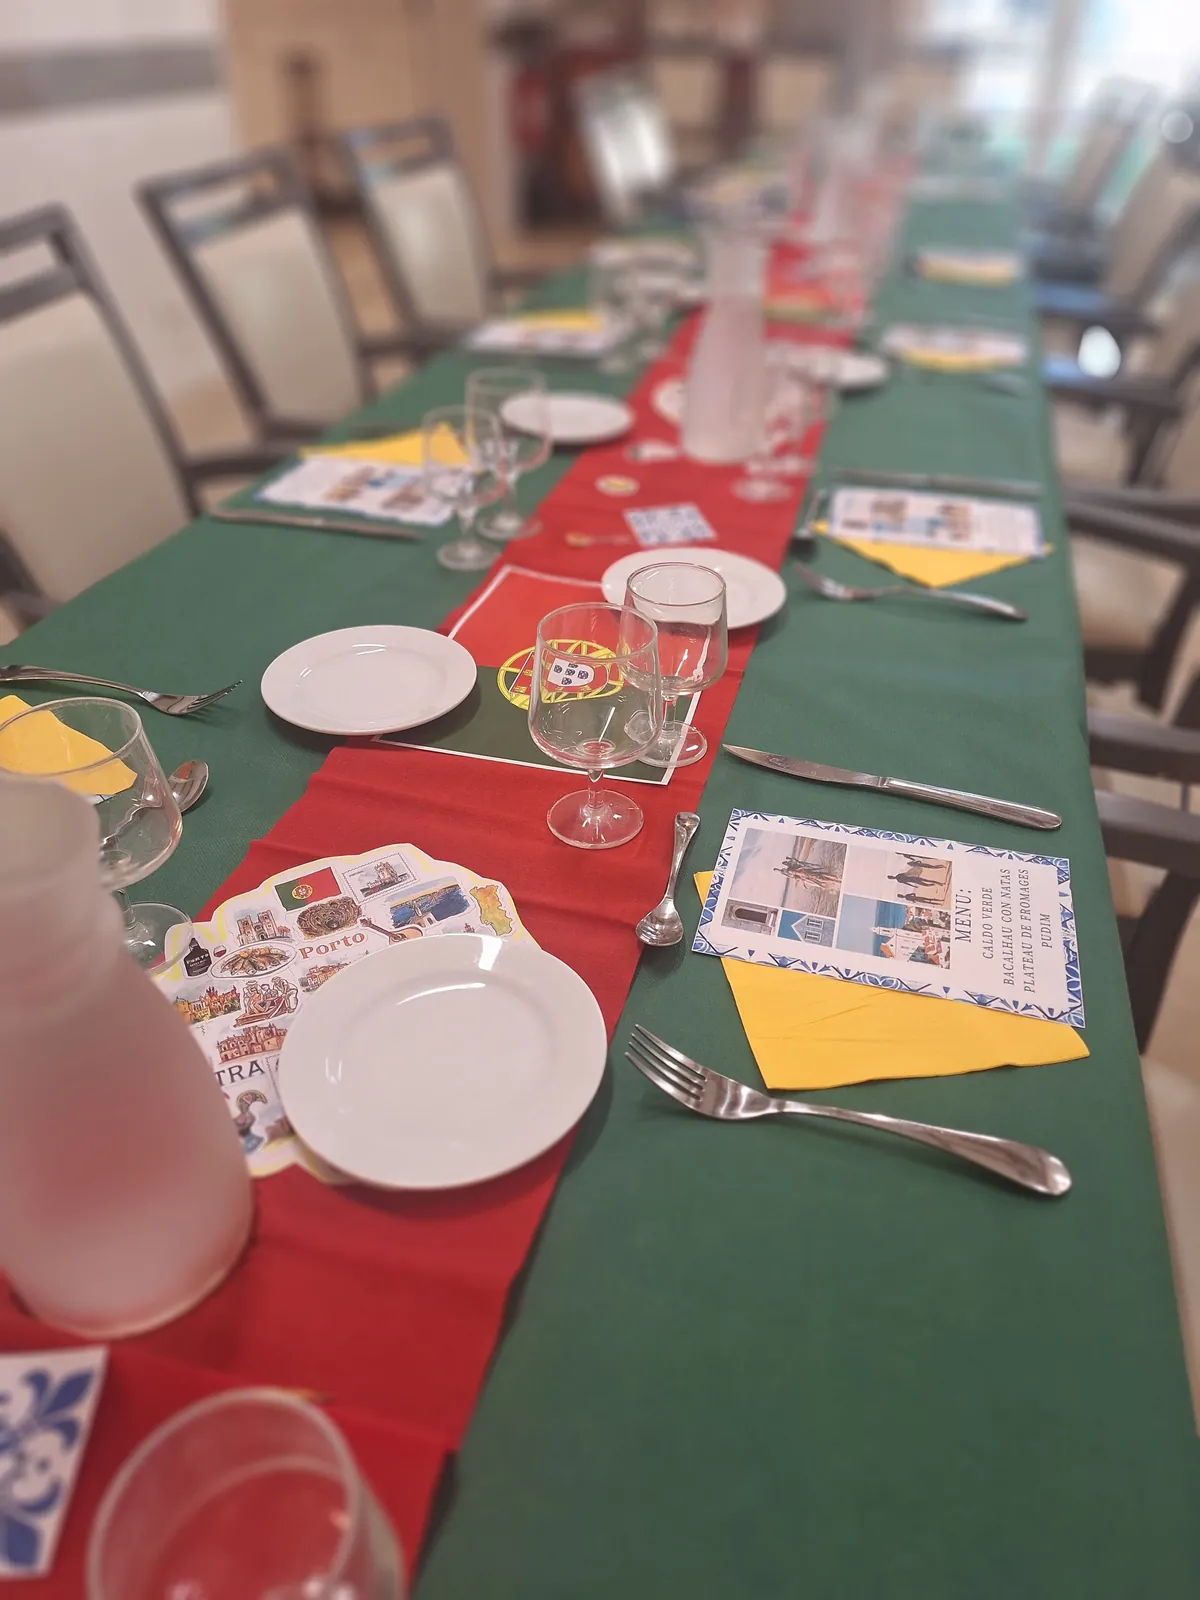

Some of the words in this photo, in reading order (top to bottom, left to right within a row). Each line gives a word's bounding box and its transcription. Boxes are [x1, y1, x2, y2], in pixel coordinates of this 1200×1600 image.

[1000, 868, 1011, 899] NATAS
[1018, 869, 1031, 921] FROMAGES
[955, 889, 971, 943] MENU:
[982, 887, 993, 919] VERDE
[1001, 902, 1012, 923] CON
[298, 932, 365, 960] Porto
[982, 923, 994, 959] CALDO
[1021, 924, 1032, 939] DE
[1040, 913, 1052, 949] PUDIM
[1001, 926, 1014, 986] BACALHAU
[1022, 942, 1035, 994] PLATEAU
[215, 1060, 266, 1086] TRA
